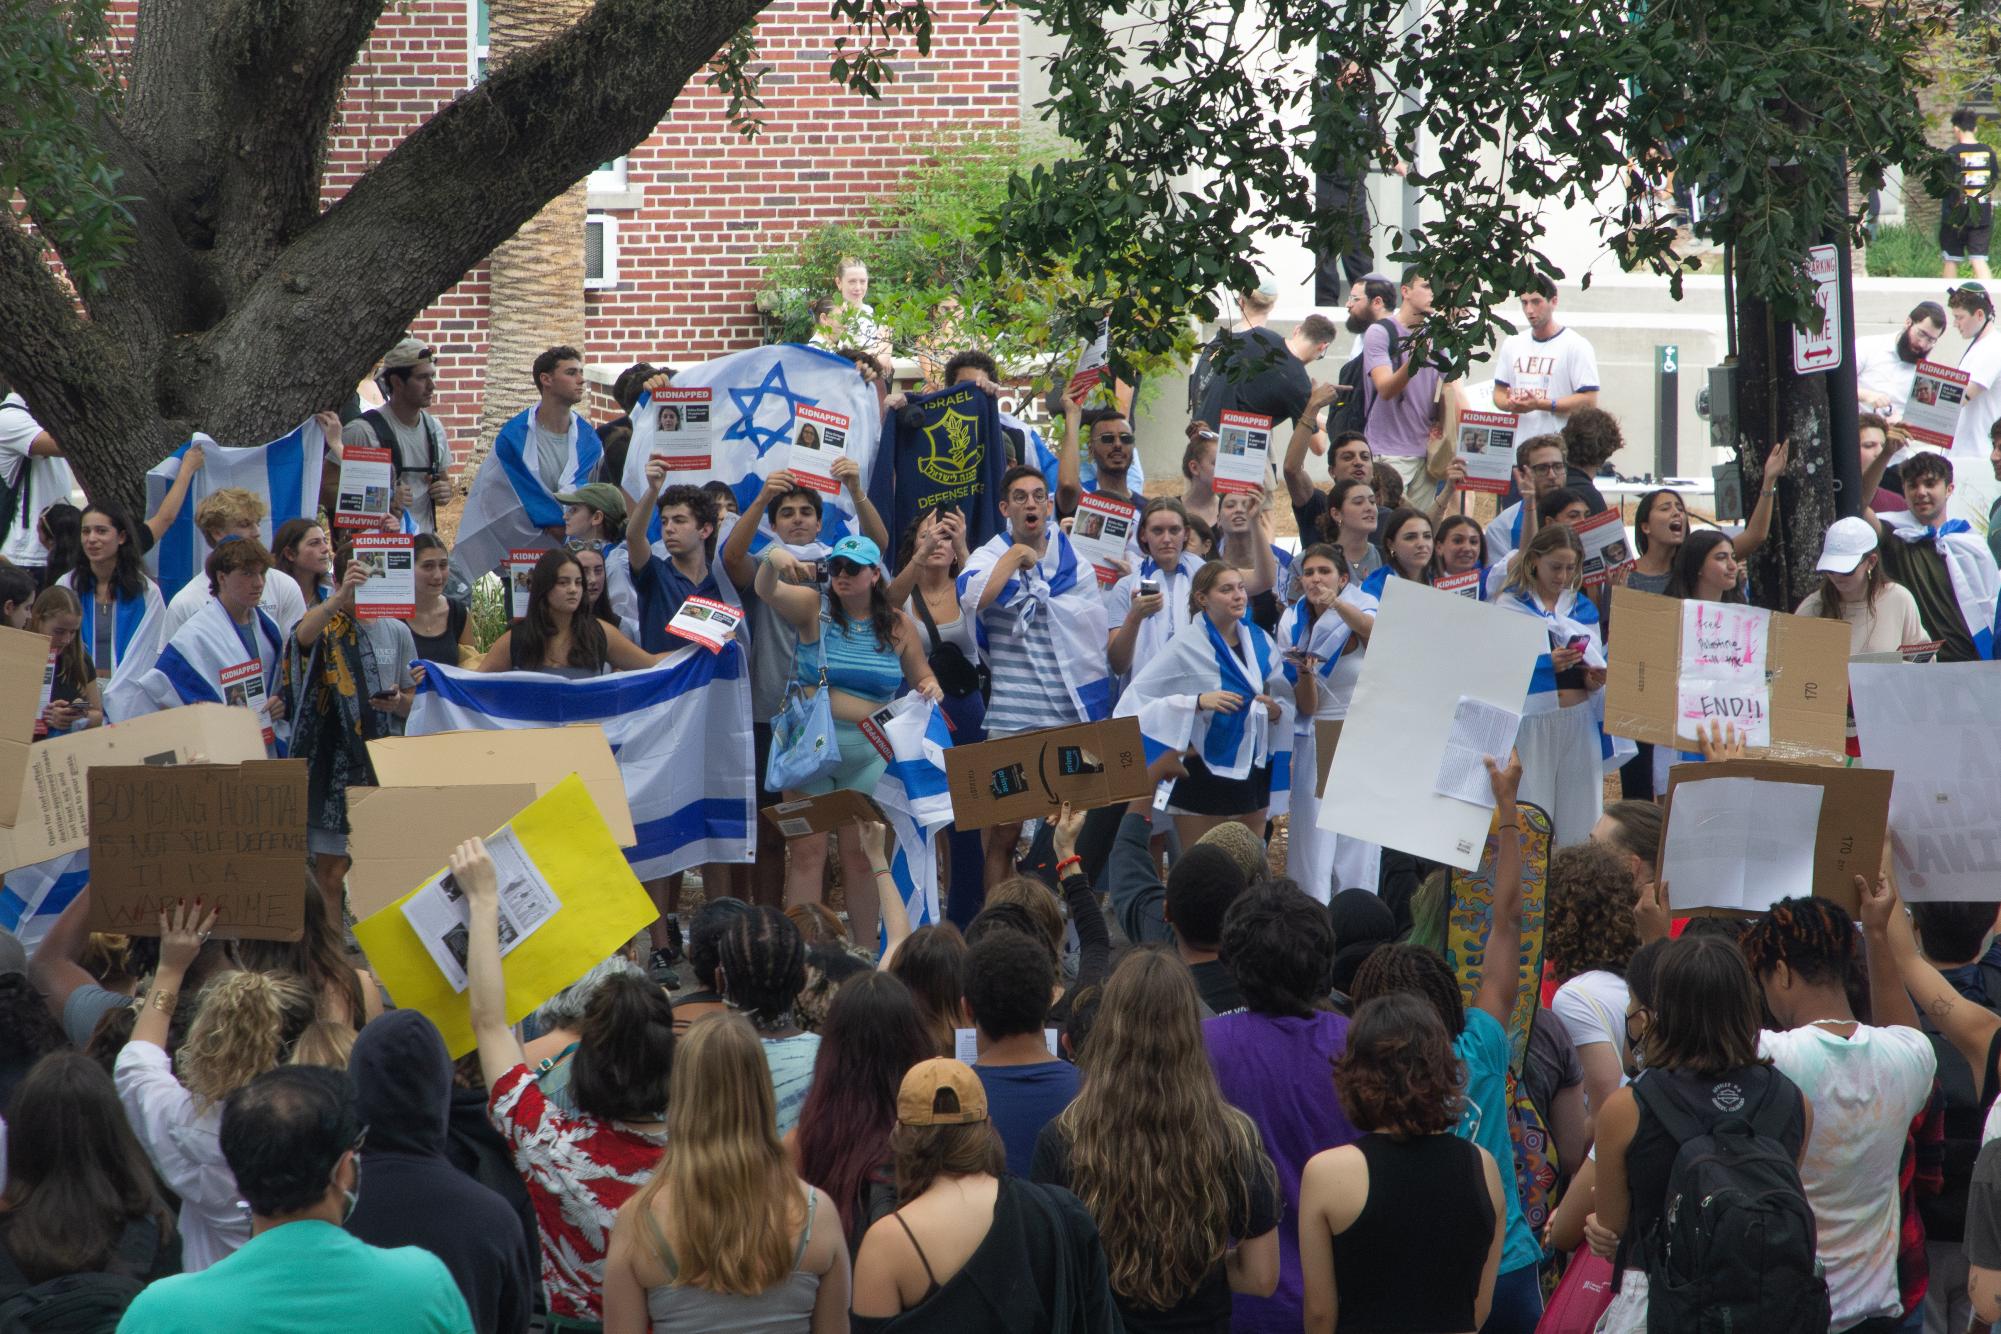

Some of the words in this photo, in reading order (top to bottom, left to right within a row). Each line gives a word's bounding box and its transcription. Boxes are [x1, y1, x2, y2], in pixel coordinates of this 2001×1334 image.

[1919, 362, 1967, 380] KIDNAPPED
[655, 391, 709, 399] KIDNAPPED
[924, 391, 974, 410] ISRAEL
[799, 407, 847, 426] KIDNAPPED
[1223, 413, 1269, 426] KIDNAPPED
[1463, 412, 1515, 424] KIDNAPPED
[918, 486, 969, 508] DEFENSE
[1082, 496, 1132, 515] KIDNAPPED
[338, 516, 379, 526] DNAPPED
[356, 537, 410, 545] KIDNAPPED
[512, 552, 543, 560] KIDNA
[1437, 573, 1478, 589] KIDNAPPED
[690, 597, 741, 617] KIDNAPPED
[221, 663, 260, 680] KIDNAPPED
[1804, 682, 1818, 700] 170
[1701, 696, 1761, 723] END!!
[1065, 750, 1074, 774] prime
[1120, 750, 1133, 768] 128
[998, 770, 1009, 792] prime
[1841, 835, 1853, 855] 170
[200, 892, 289, 924] RIME
